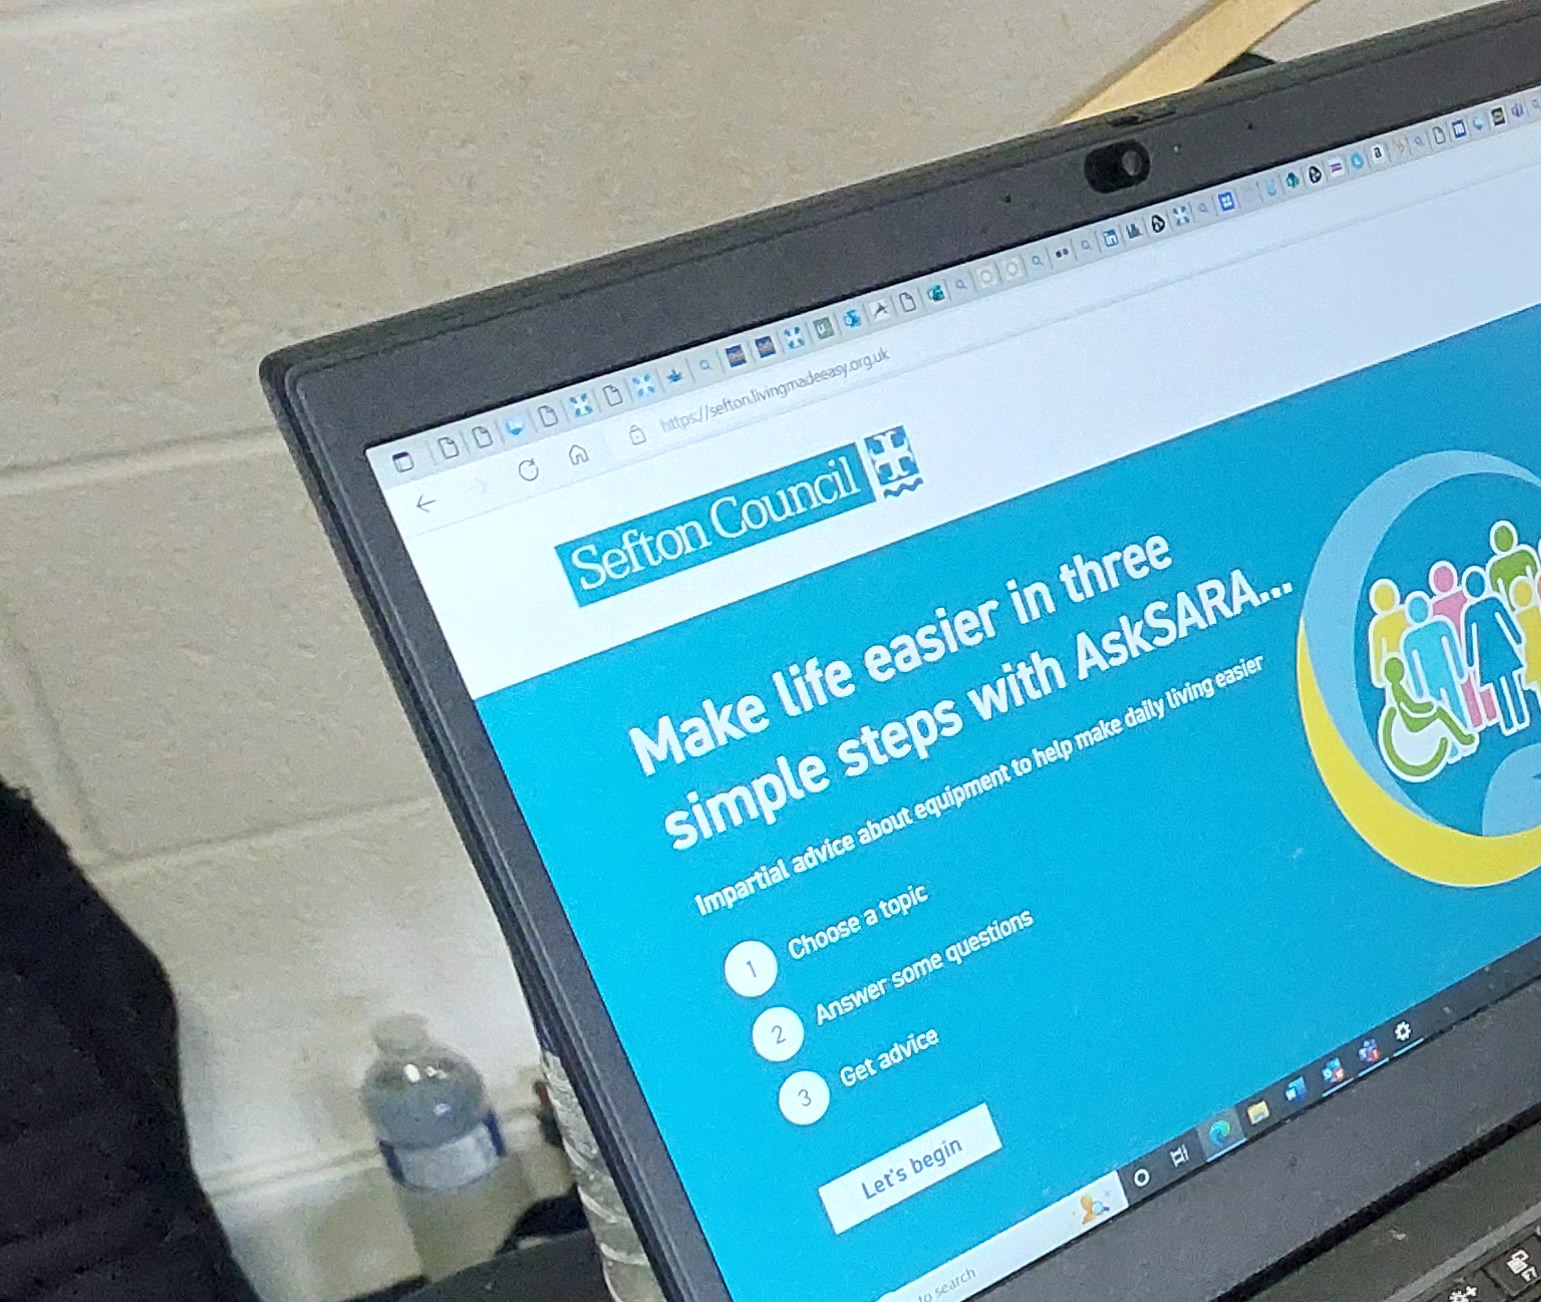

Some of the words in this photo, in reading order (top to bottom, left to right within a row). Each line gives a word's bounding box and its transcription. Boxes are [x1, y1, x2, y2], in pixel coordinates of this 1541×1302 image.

[571, 520, 711, 590] Sefton
[709, 456, 860, 538] Council
[628, 694, 769, 775] Make
[771, 656, 855, 716] life
[863, 599, 998, 681] easier
[1006, 579, 1056, 624] in
[1059, 535, 1172, 602] three
[664, 755, 830, 850] simple
[836, 699, 963, 776] steps
[967, 650, 1066, 720] with
[1076, 569, 1292, 680] AskSARA...
[694, 858, 790, 915] Impartial
[791, 834, 855, 873] advice
[856, 807, 913, 844] about
[914, 764, 1011, 819] equipment
[1010, 757, 1032, 776] to
[1031, 739, 1073, 767] help
[1074, 717, 1123, 750] make
[1124, 698, 1164, 727] daily
[1164, 677, 1215, 708] living
[1213, 655, 1263, 688] easier
[787, 915, 861, 959] Choose
[863, 908, 878, 925] a
[878, 885, 928, 918] topic
[745, 959, 757, 978] 1
[816, 978, 887, 1025] Answer
[891, 952, 944, 988] some
[945, 910, 1033, 964] questions
[770, 1023, 787, 1045] 2
[839, 1058, 877, 1087] Get
[877, 1028, 939, 1069] advice
[796, 1087, 812, 1108] 3
[861, 1167, 907, 1199] Let's
[909, 1139, 962, 1174] begin
[934, 1268, 976, 1299] search
